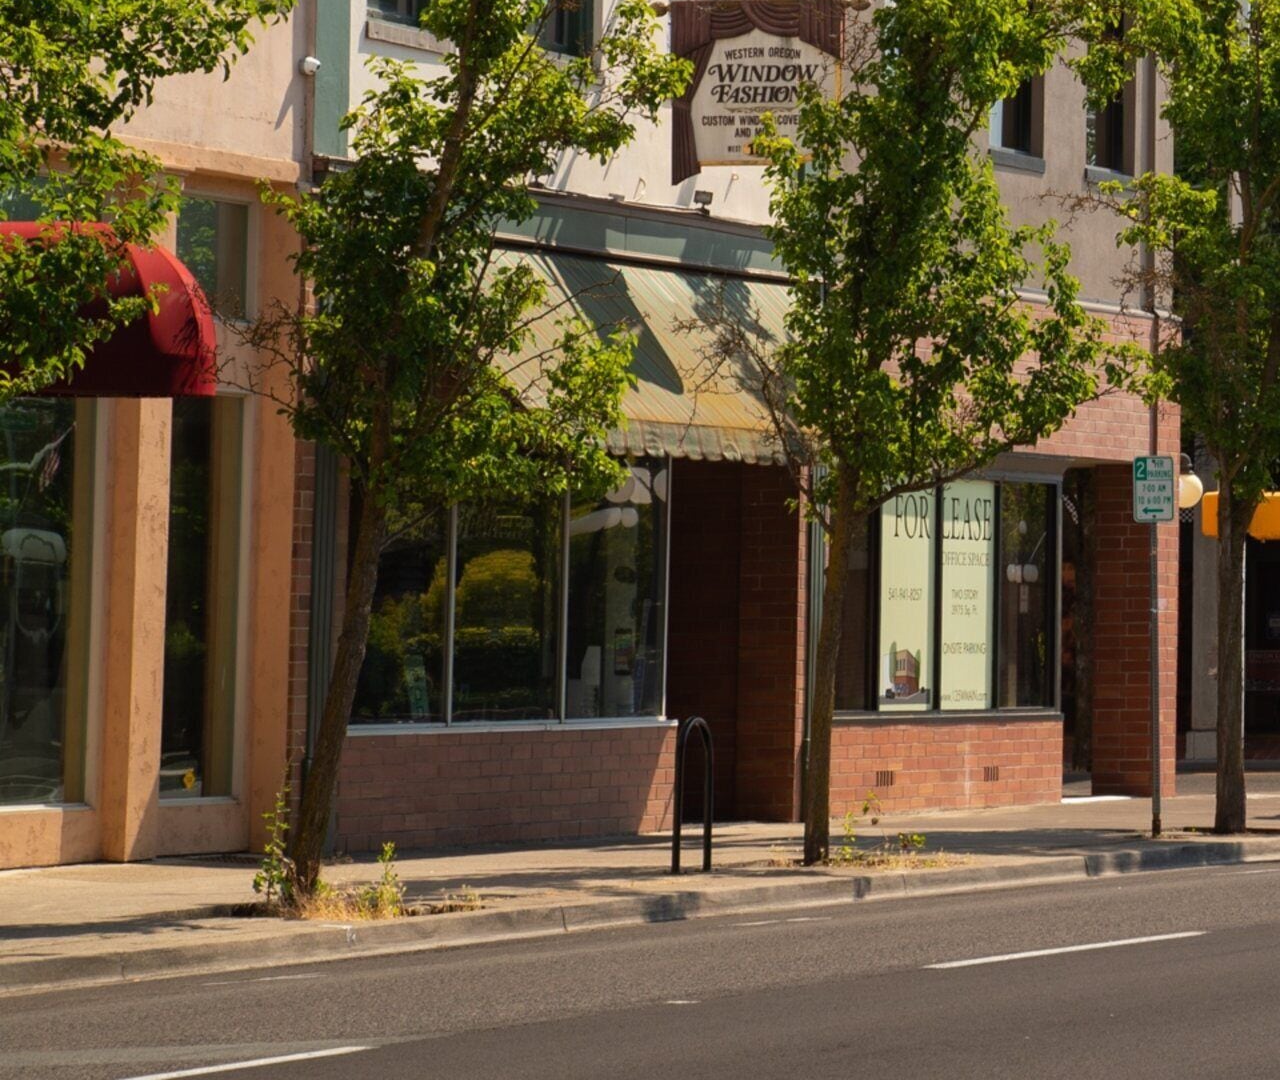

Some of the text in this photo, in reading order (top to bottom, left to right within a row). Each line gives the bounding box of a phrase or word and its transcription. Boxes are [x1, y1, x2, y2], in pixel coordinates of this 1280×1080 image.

[724, 47, 801, 60] WESTERN OREGON
[708, 63, 819, 83] WINDOW
[710, 84, 801, 104] FASHION
[702, 115, 735, 126] CUSTOM
[735, 128, 751, 137] AND
[1136, 461, 1145, 479] 2
[1147, 470, 1172, 478] PARKING
[1158, 484, 1166, 492] AM
[894, 494, 931, 539] FOR
[968, 552, 990, 566] SPACE
